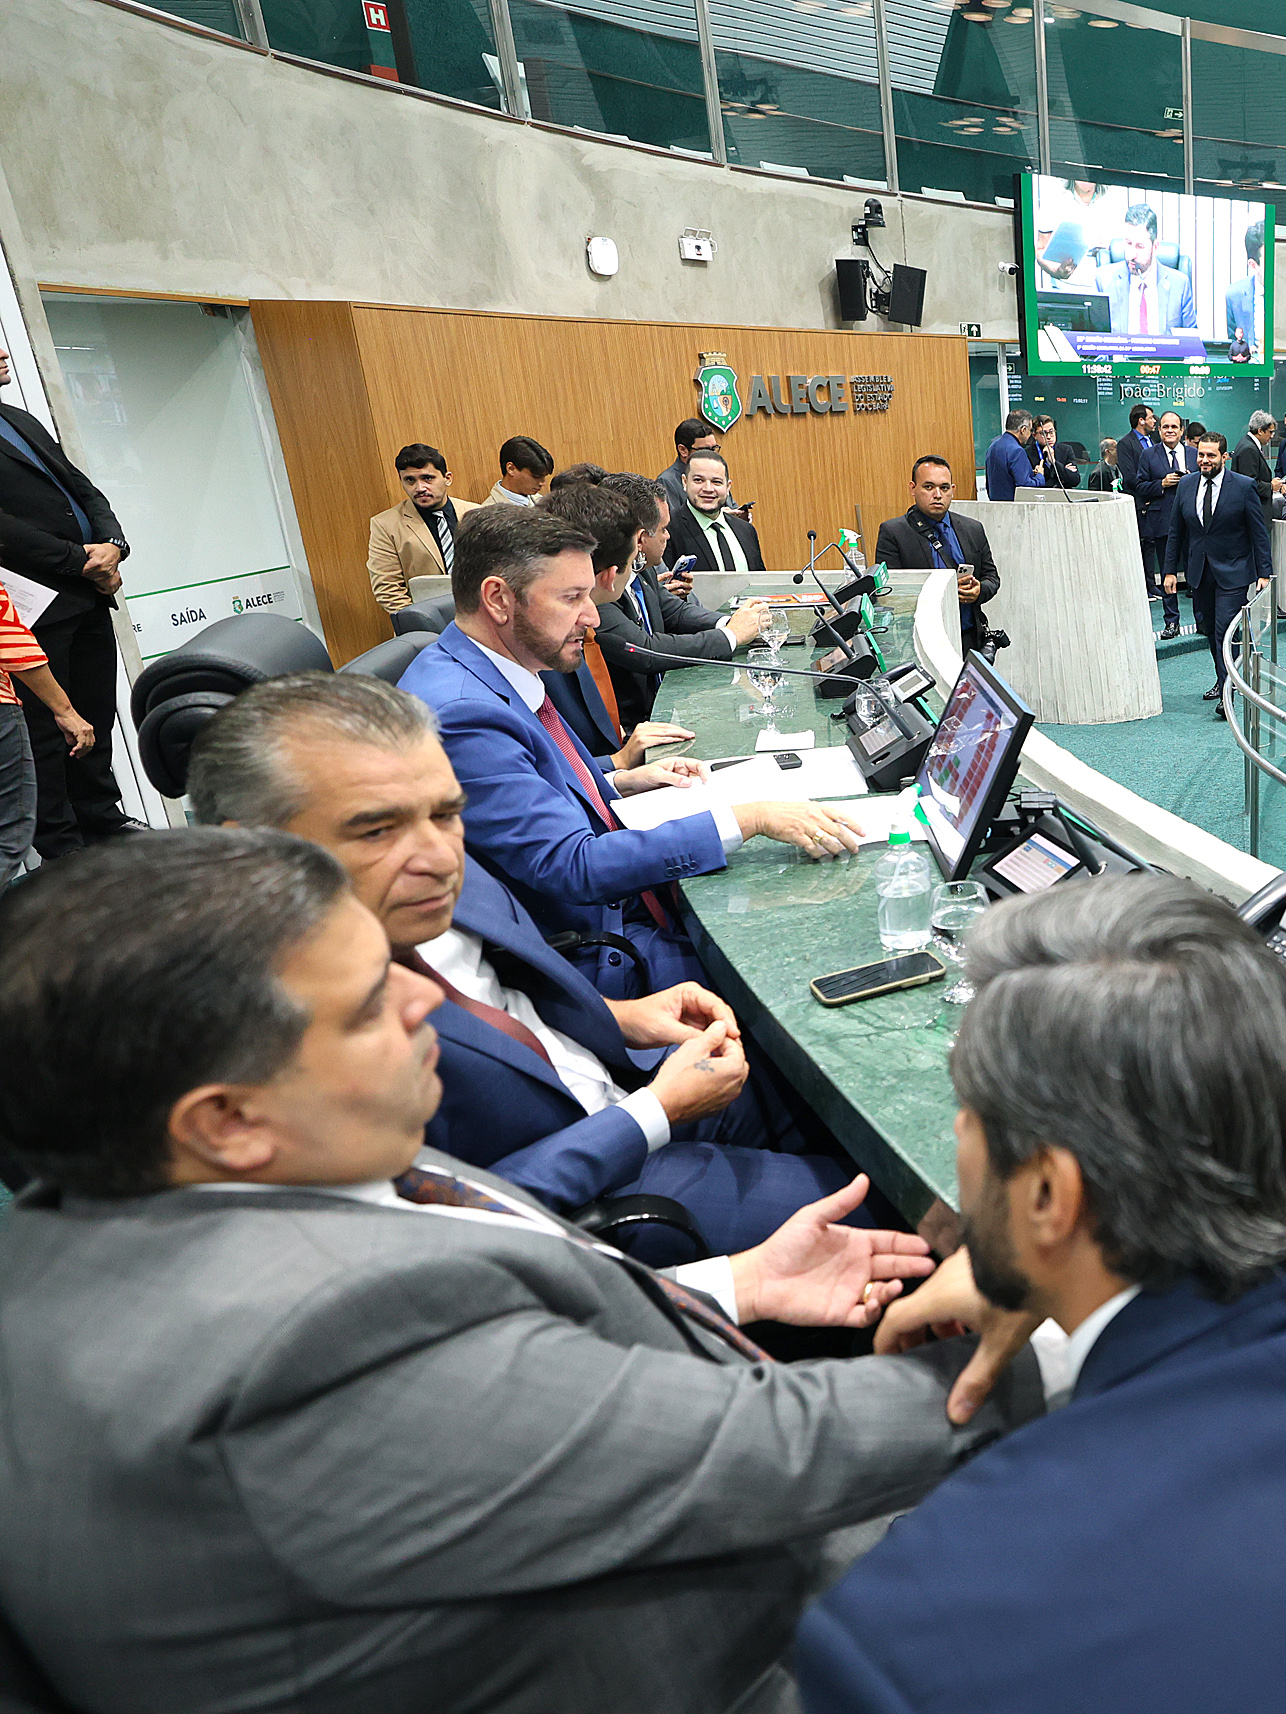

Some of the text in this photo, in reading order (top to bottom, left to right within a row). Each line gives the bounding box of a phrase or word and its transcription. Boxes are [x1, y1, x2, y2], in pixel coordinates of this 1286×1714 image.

[368, 7, 387, 26] H
[746, 375, 849, 416] ALECE
[853, 384, 895, 392] LEGISLATIVA
[854, 393, 893, 402] DO ESTADO
[1119, 383, 1152, 402] João
[1156, 382, 1206, 403] Brígido
[245, 593, 274, 610] ALECE
[170, 606, 207, 627] SAÍDA
